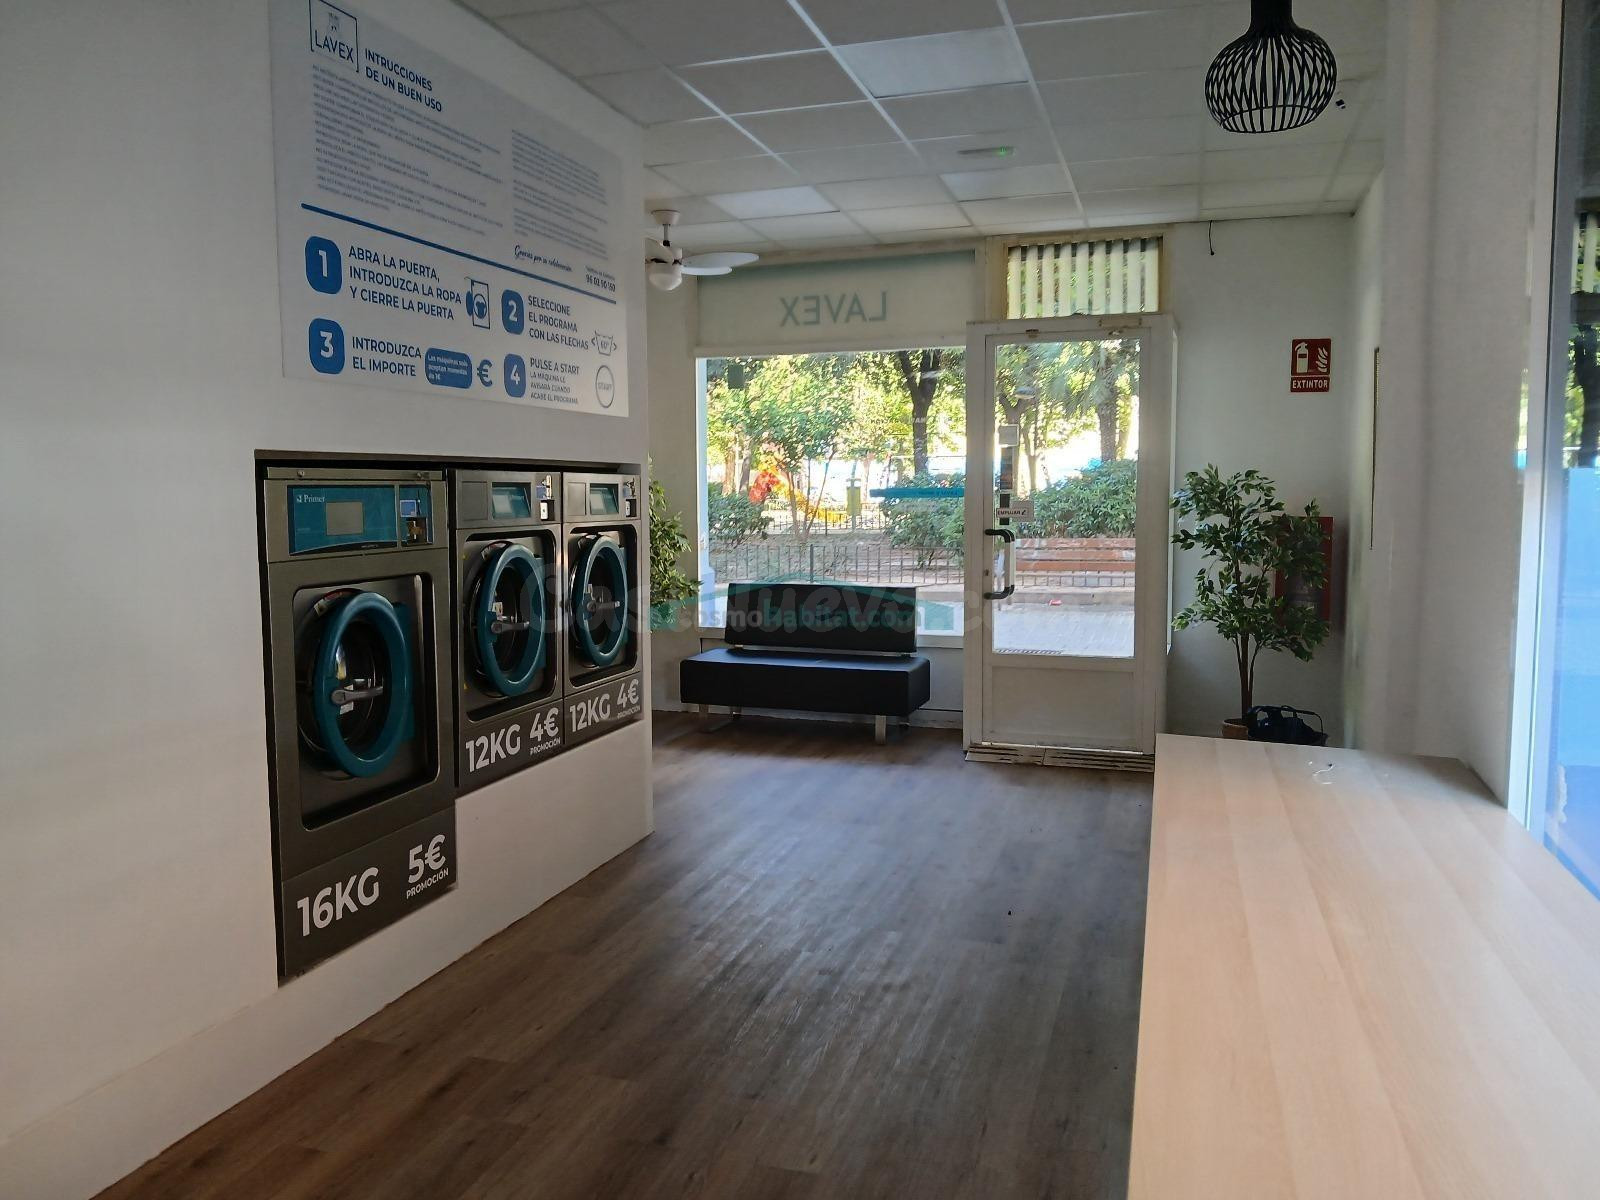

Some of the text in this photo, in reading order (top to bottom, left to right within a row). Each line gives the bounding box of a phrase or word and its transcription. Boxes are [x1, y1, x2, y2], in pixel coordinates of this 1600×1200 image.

[315, 30, 354, 62] LAVEX
[365, 48, 433, 91] INTRUCCIONES
[365, 66, 442, 112] DE UN BUEN USO
[348, 246, 440, 282] ABRA LA PUERTA,
[349, 266, 461, 305] INTRODUZCA LA ROPA
[350, 286, 454, 320] Y CIERRE LA PUERTA
[528, 295, 571, 316] SELECCIONE
[528, 311, 578, 332] EL PROGRAMA
[352, 336, 422, 359] INTRODUZCA
[529, 328, 589, 349] CON LAS FLECHAS
[352, 356, 417, 376] EL IMPORTE
[530, 358, 580, 375] PULSE A START
[1292, 379, 1328, 389] EXTINTOR
[304, 494, 326, 503] Primer
[569, 679, 639, 732] 12KG 4€
[465, 707, 559, 773] 12KG 4€
[297, 834, 446, 937] 16KG 5€
[406, 867, 449, 899] PROMOCIÓN
